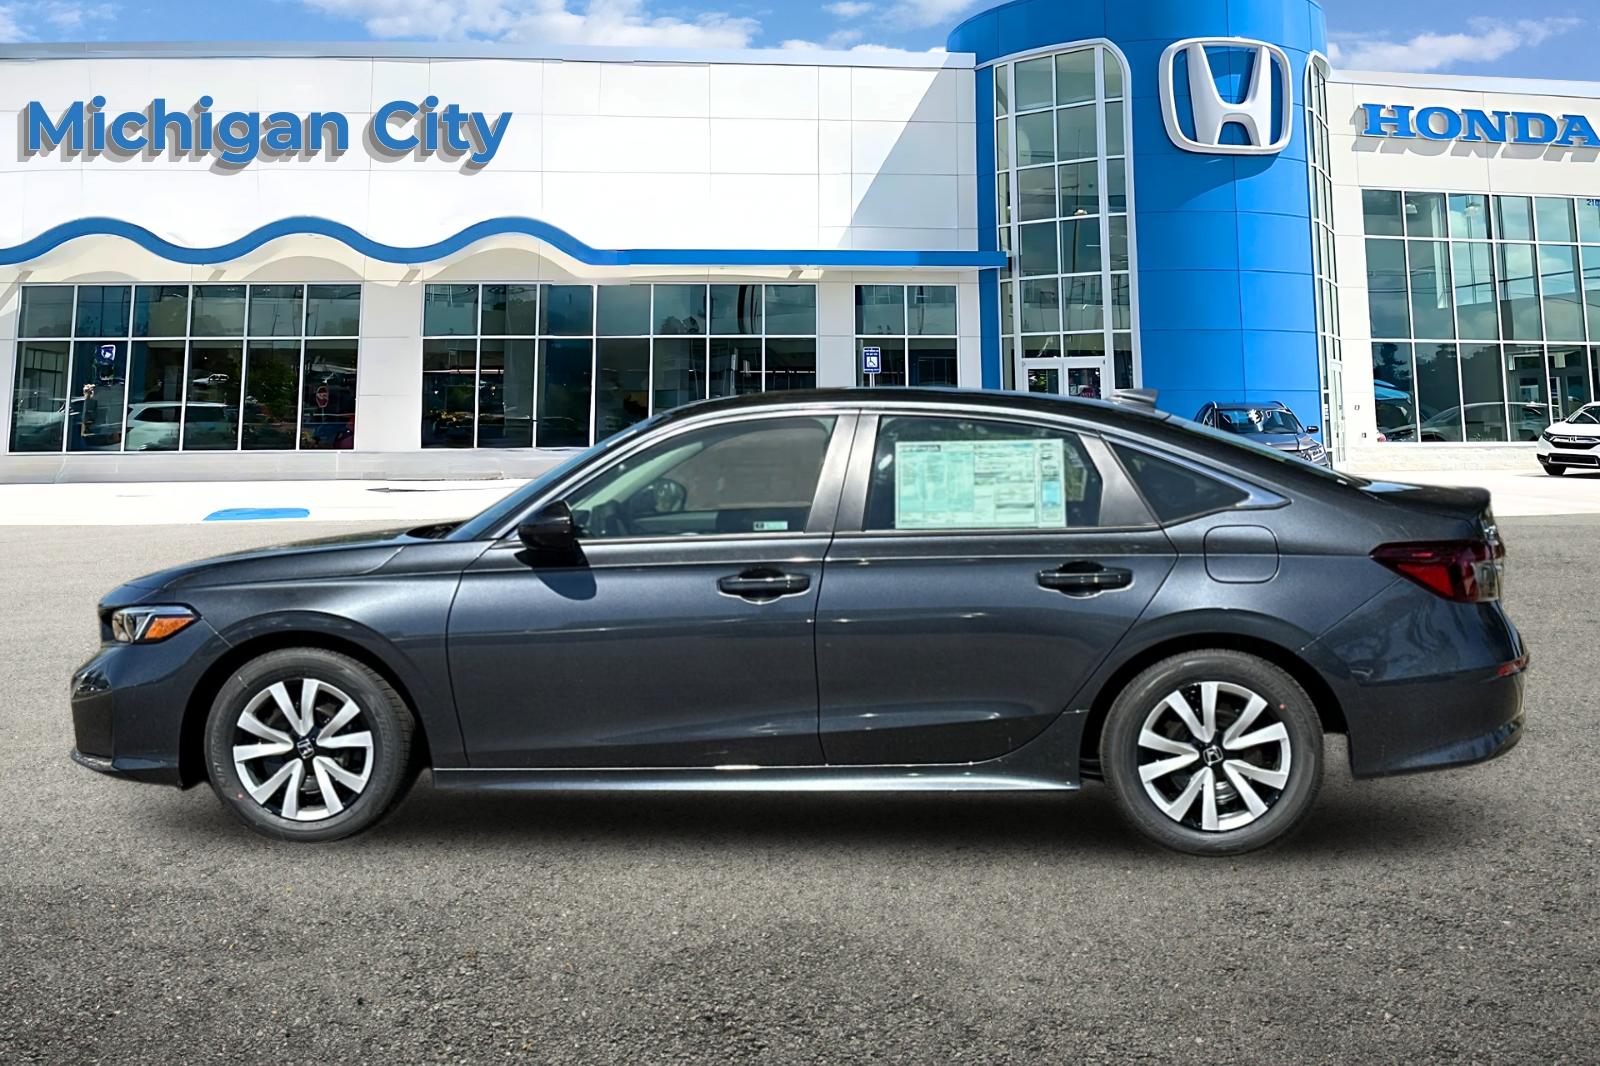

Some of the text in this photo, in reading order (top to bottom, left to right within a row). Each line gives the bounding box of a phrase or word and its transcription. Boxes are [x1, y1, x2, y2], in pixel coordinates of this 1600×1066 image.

[28, 95, 513, 163] Michigan City
[1361, 103, 1600, 147] HONDA
